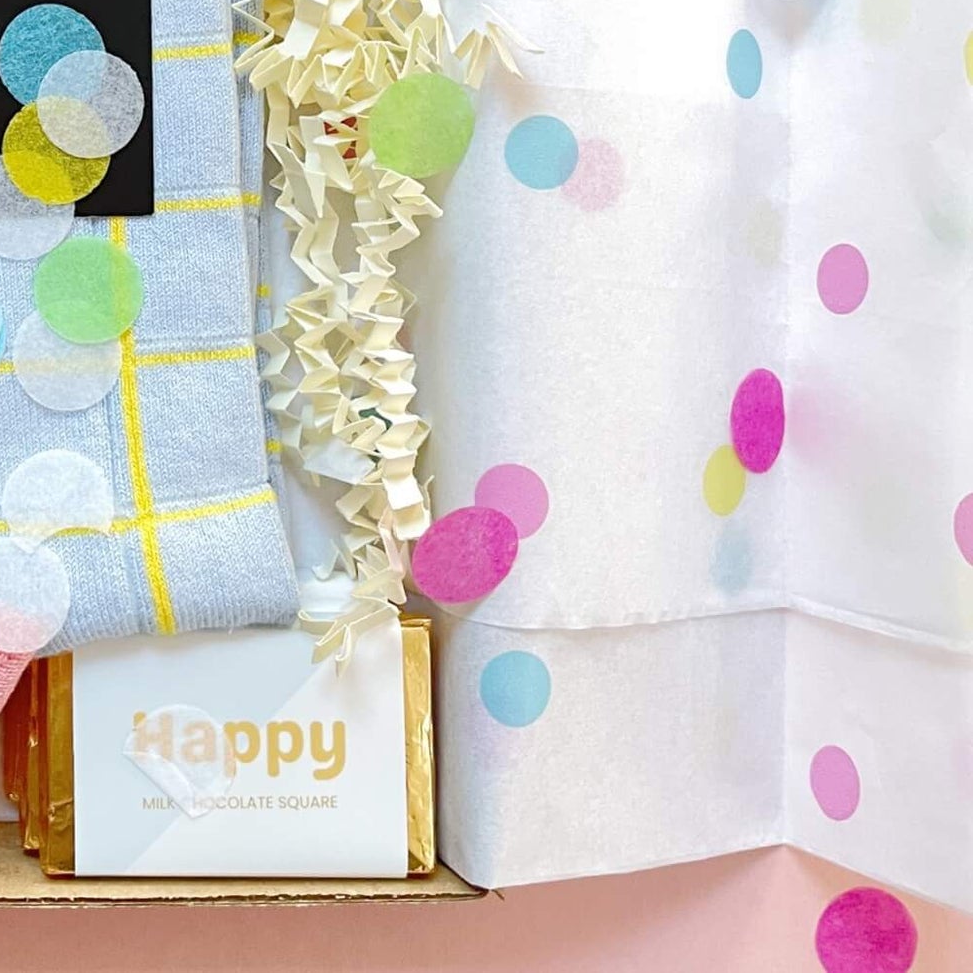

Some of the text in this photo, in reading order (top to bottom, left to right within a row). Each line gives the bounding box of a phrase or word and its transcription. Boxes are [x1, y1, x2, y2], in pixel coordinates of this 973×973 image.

[132, 711, 347, 781] Happy
[142, 794, 339, 810] MILK HOCOLATE SQUARE
